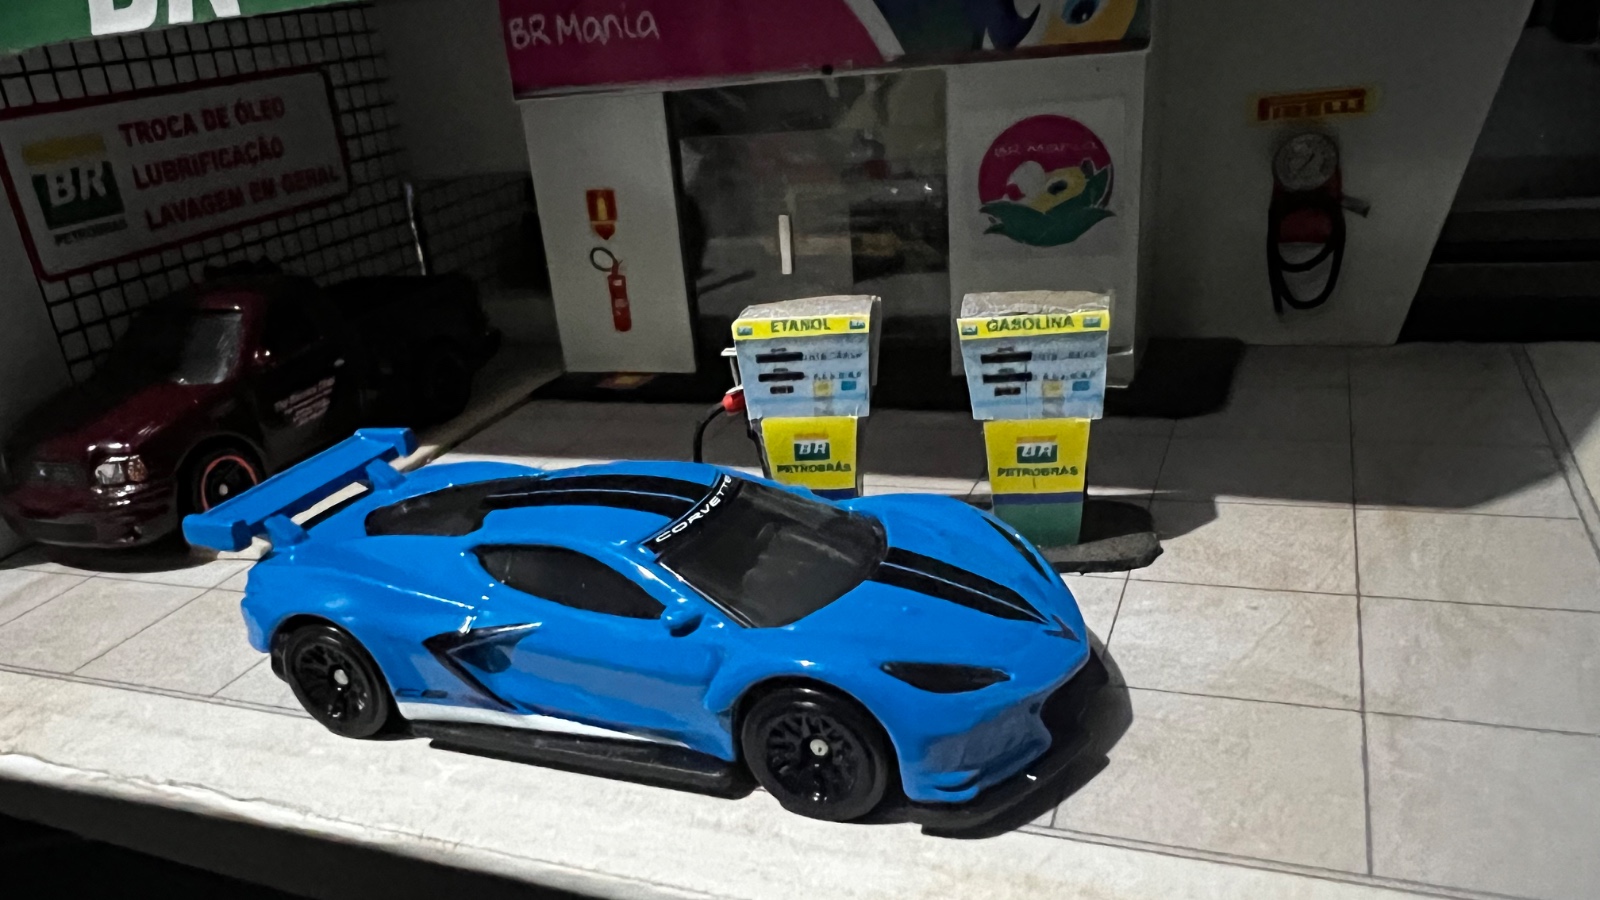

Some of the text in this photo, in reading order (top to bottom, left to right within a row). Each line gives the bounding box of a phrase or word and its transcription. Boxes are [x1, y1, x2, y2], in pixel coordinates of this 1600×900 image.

[509, 4, 660, 49] BR Mania
[118, 96, 286, 147] TROCA DE ÓLEO
[45, 161, 107, 208] BR
[132, 136, 285, 190] LUBRIFICAÇÃO
[145, 186, 246, 231] LAVAGEM
[281, 165, 340, 194] GERAL
[771, 318, 831, 333] ETANOL
[986, 315, 1075, 333] GASOLINA
